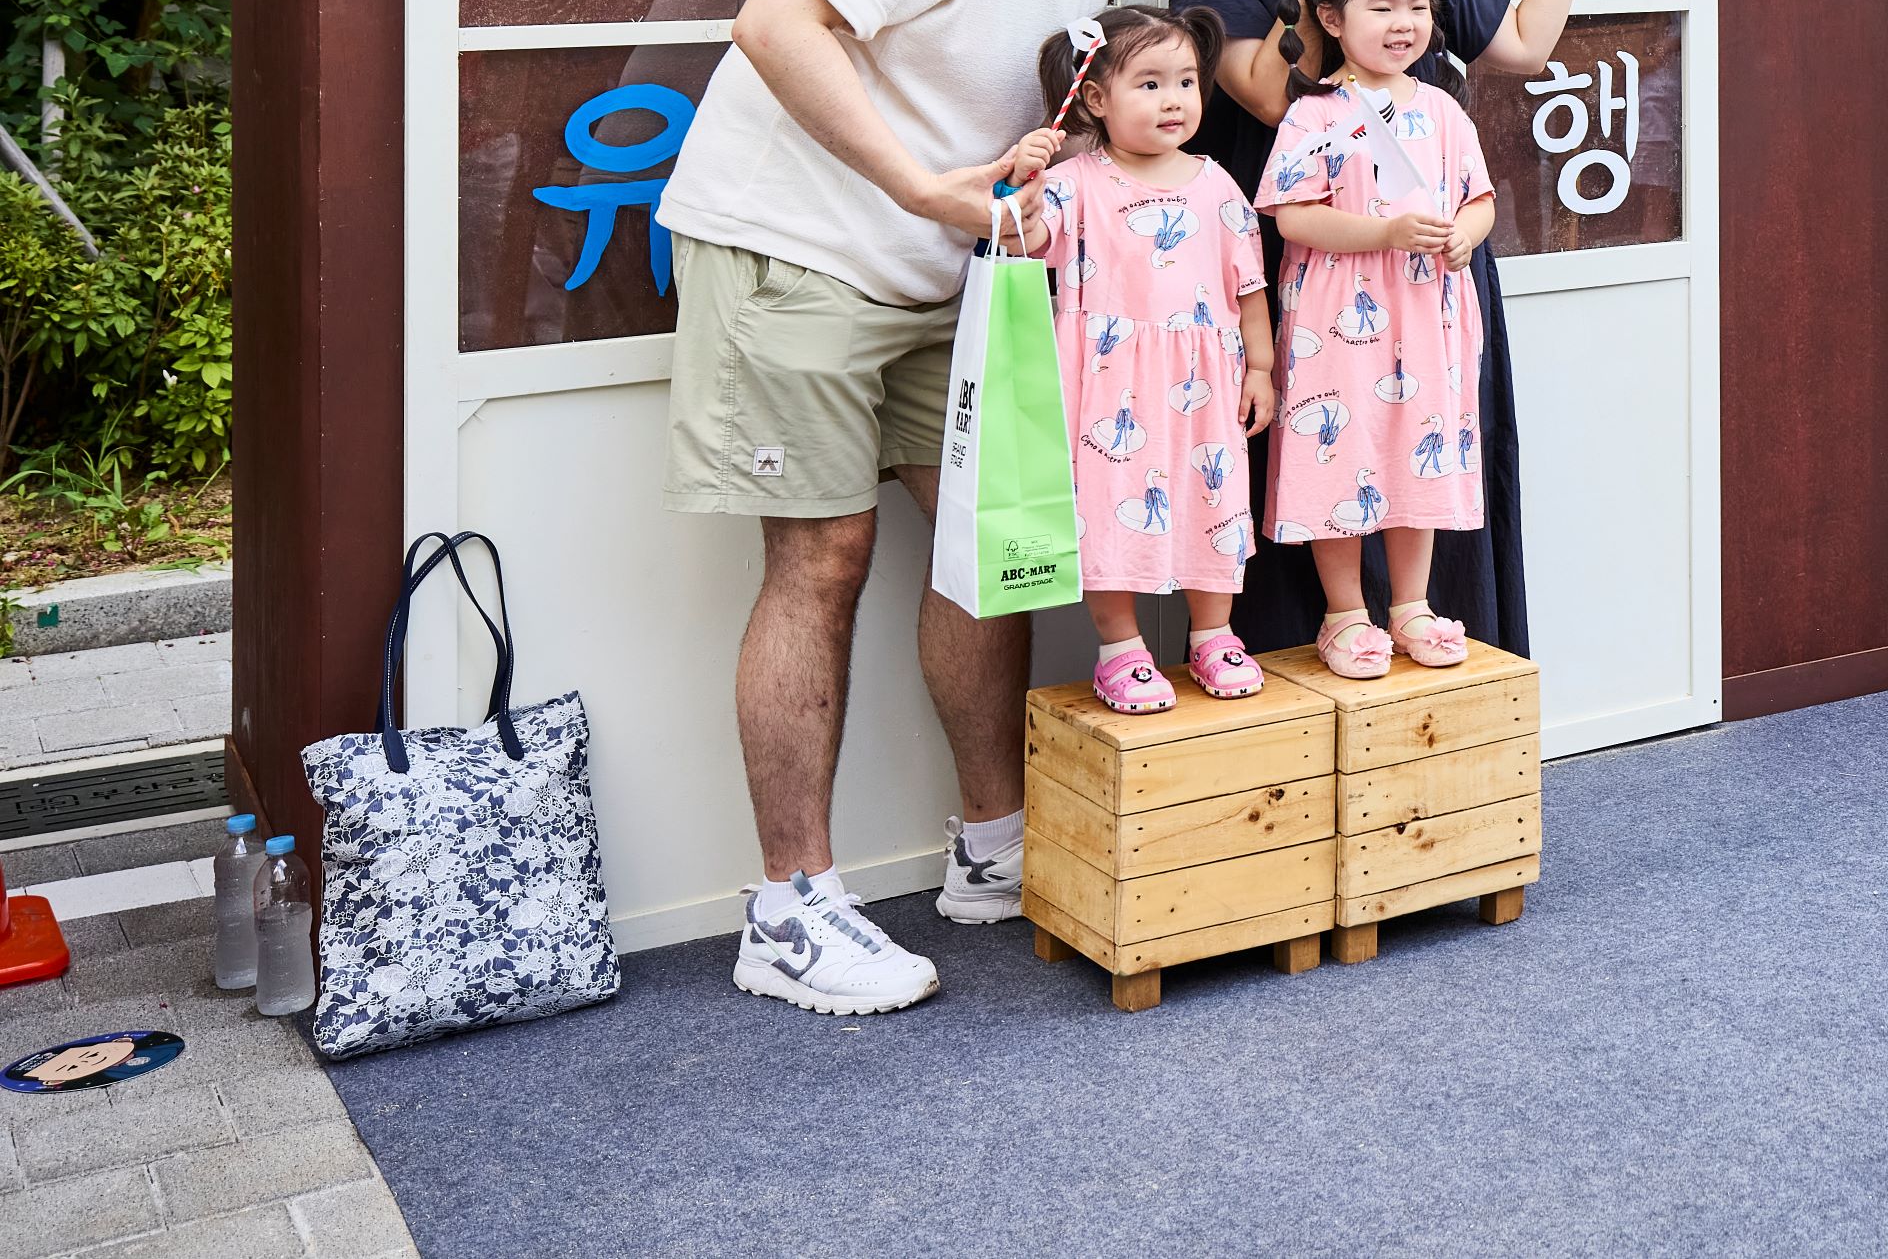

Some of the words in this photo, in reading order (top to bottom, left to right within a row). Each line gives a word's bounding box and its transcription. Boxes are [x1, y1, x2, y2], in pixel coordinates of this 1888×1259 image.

[1000, 564, 1057, 582] ABC-MART
[1003, 581, 1031, 591] GRAND
[1031, 577, 1054, 587] STAGE
